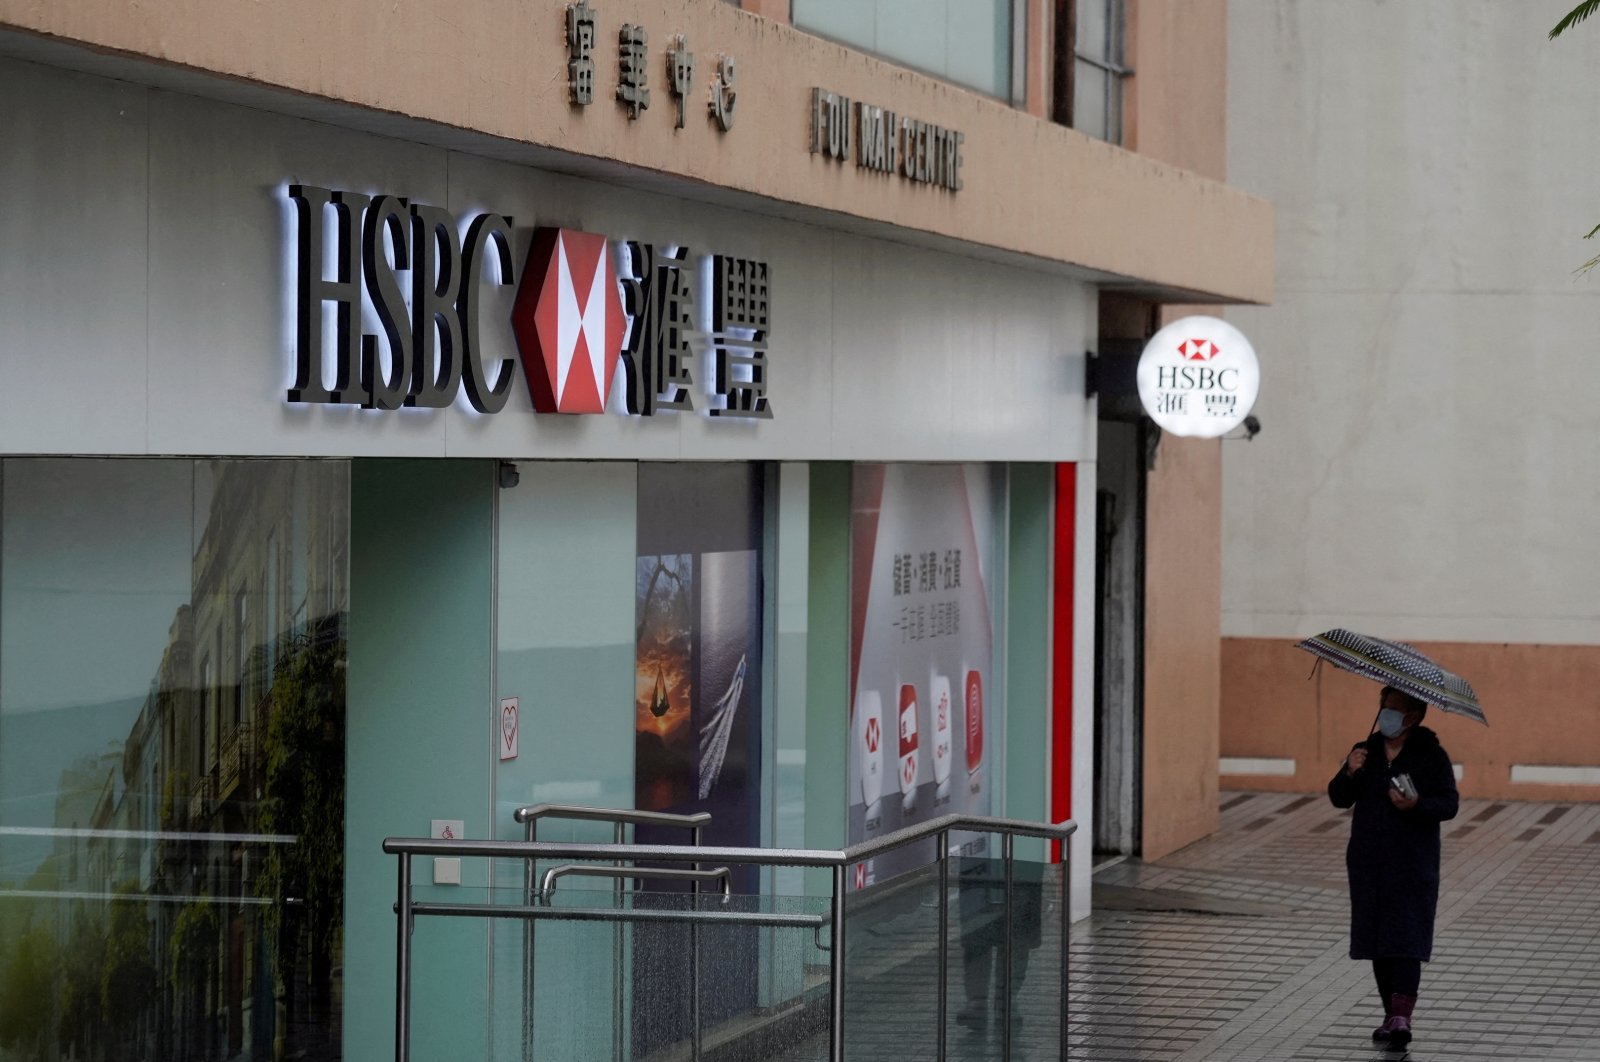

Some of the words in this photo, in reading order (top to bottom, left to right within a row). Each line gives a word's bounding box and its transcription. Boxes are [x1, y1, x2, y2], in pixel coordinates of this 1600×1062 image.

[564, 1, 736, 132] 富華中心
[810, 87, 851, 161] FOU
[855, 102, 897, 174] WAH
[901, 117, 965, 191] CENTRE
[286, 185, 515, 415] HSBC
[1157, 366, 1239, 391] HSBC
